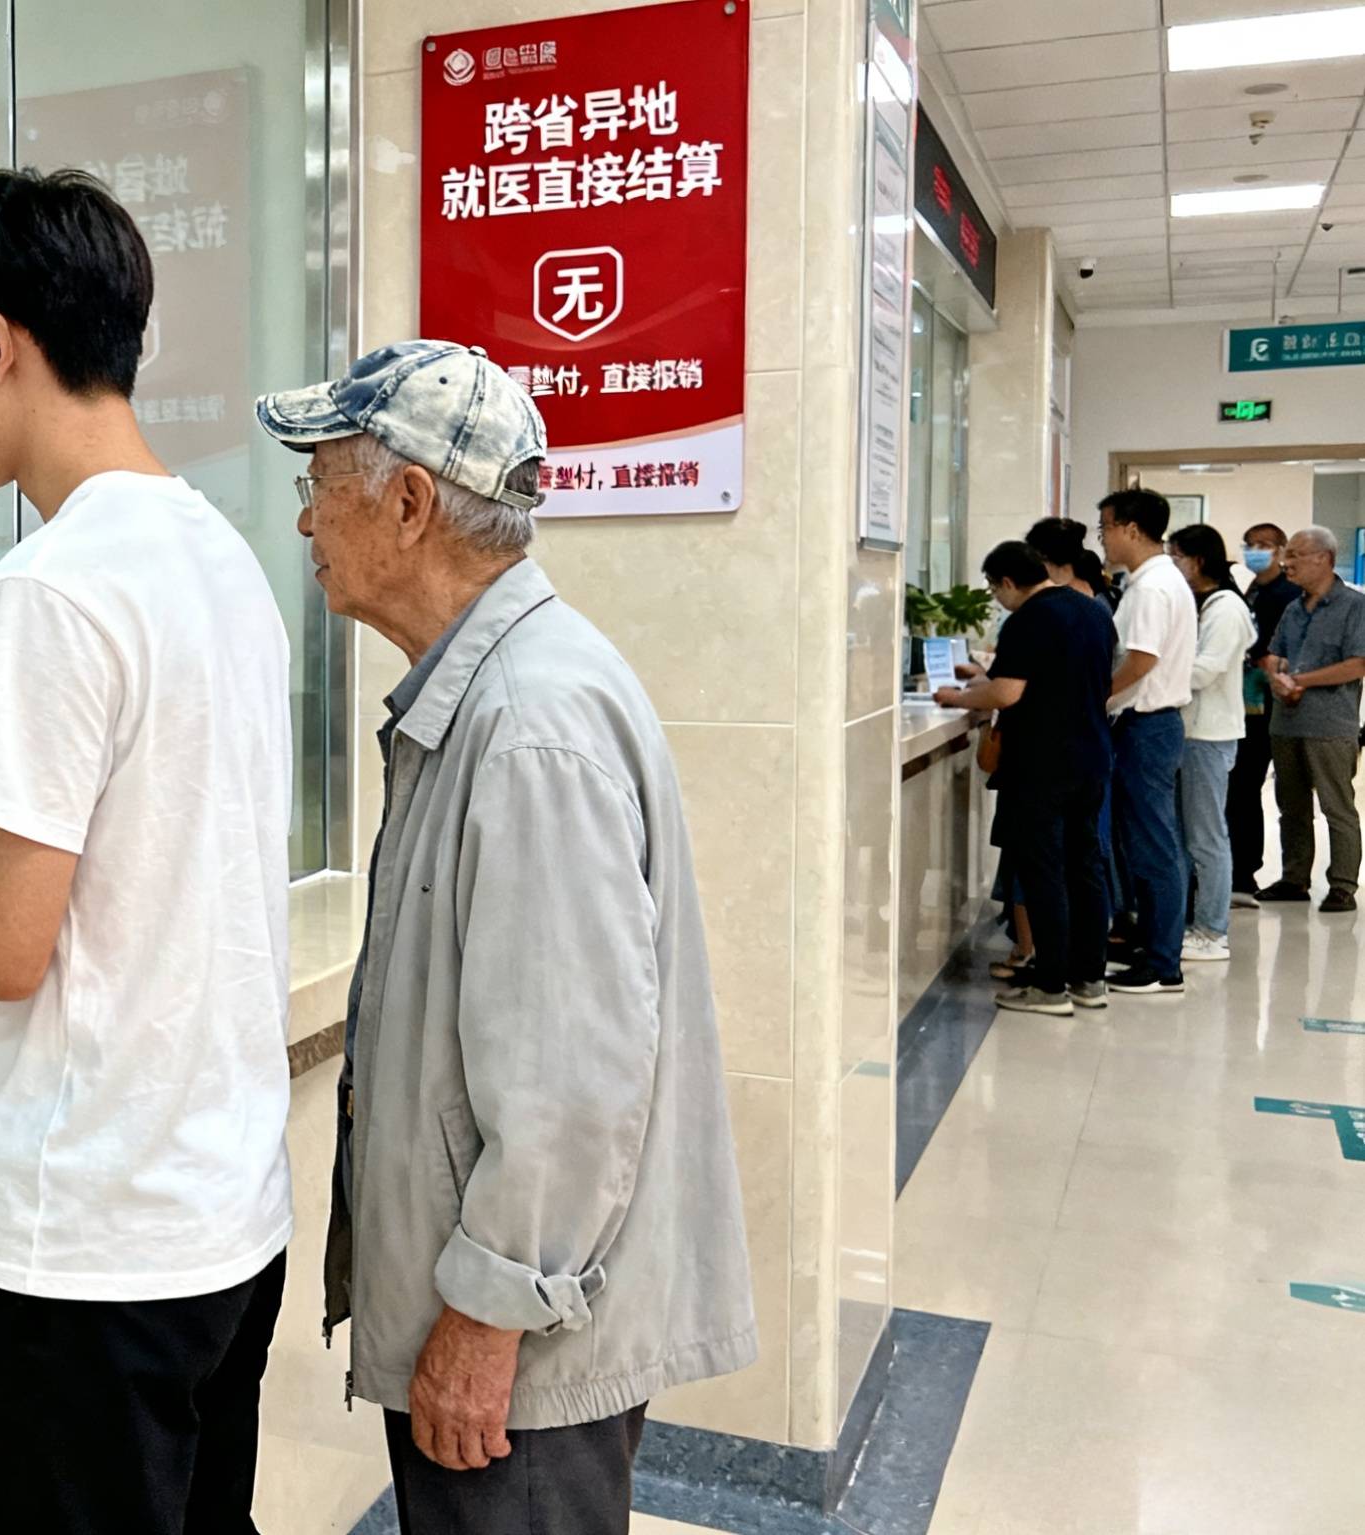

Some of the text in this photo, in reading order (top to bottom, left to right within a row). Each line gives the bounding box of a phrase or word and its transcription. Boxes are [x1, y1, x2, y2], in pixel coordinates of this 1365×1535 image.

[483, 80, 679, 155] 跨省异地
[440, 141, 724, 221] 就医直接结算
[552, 266, 604, 324] 无
